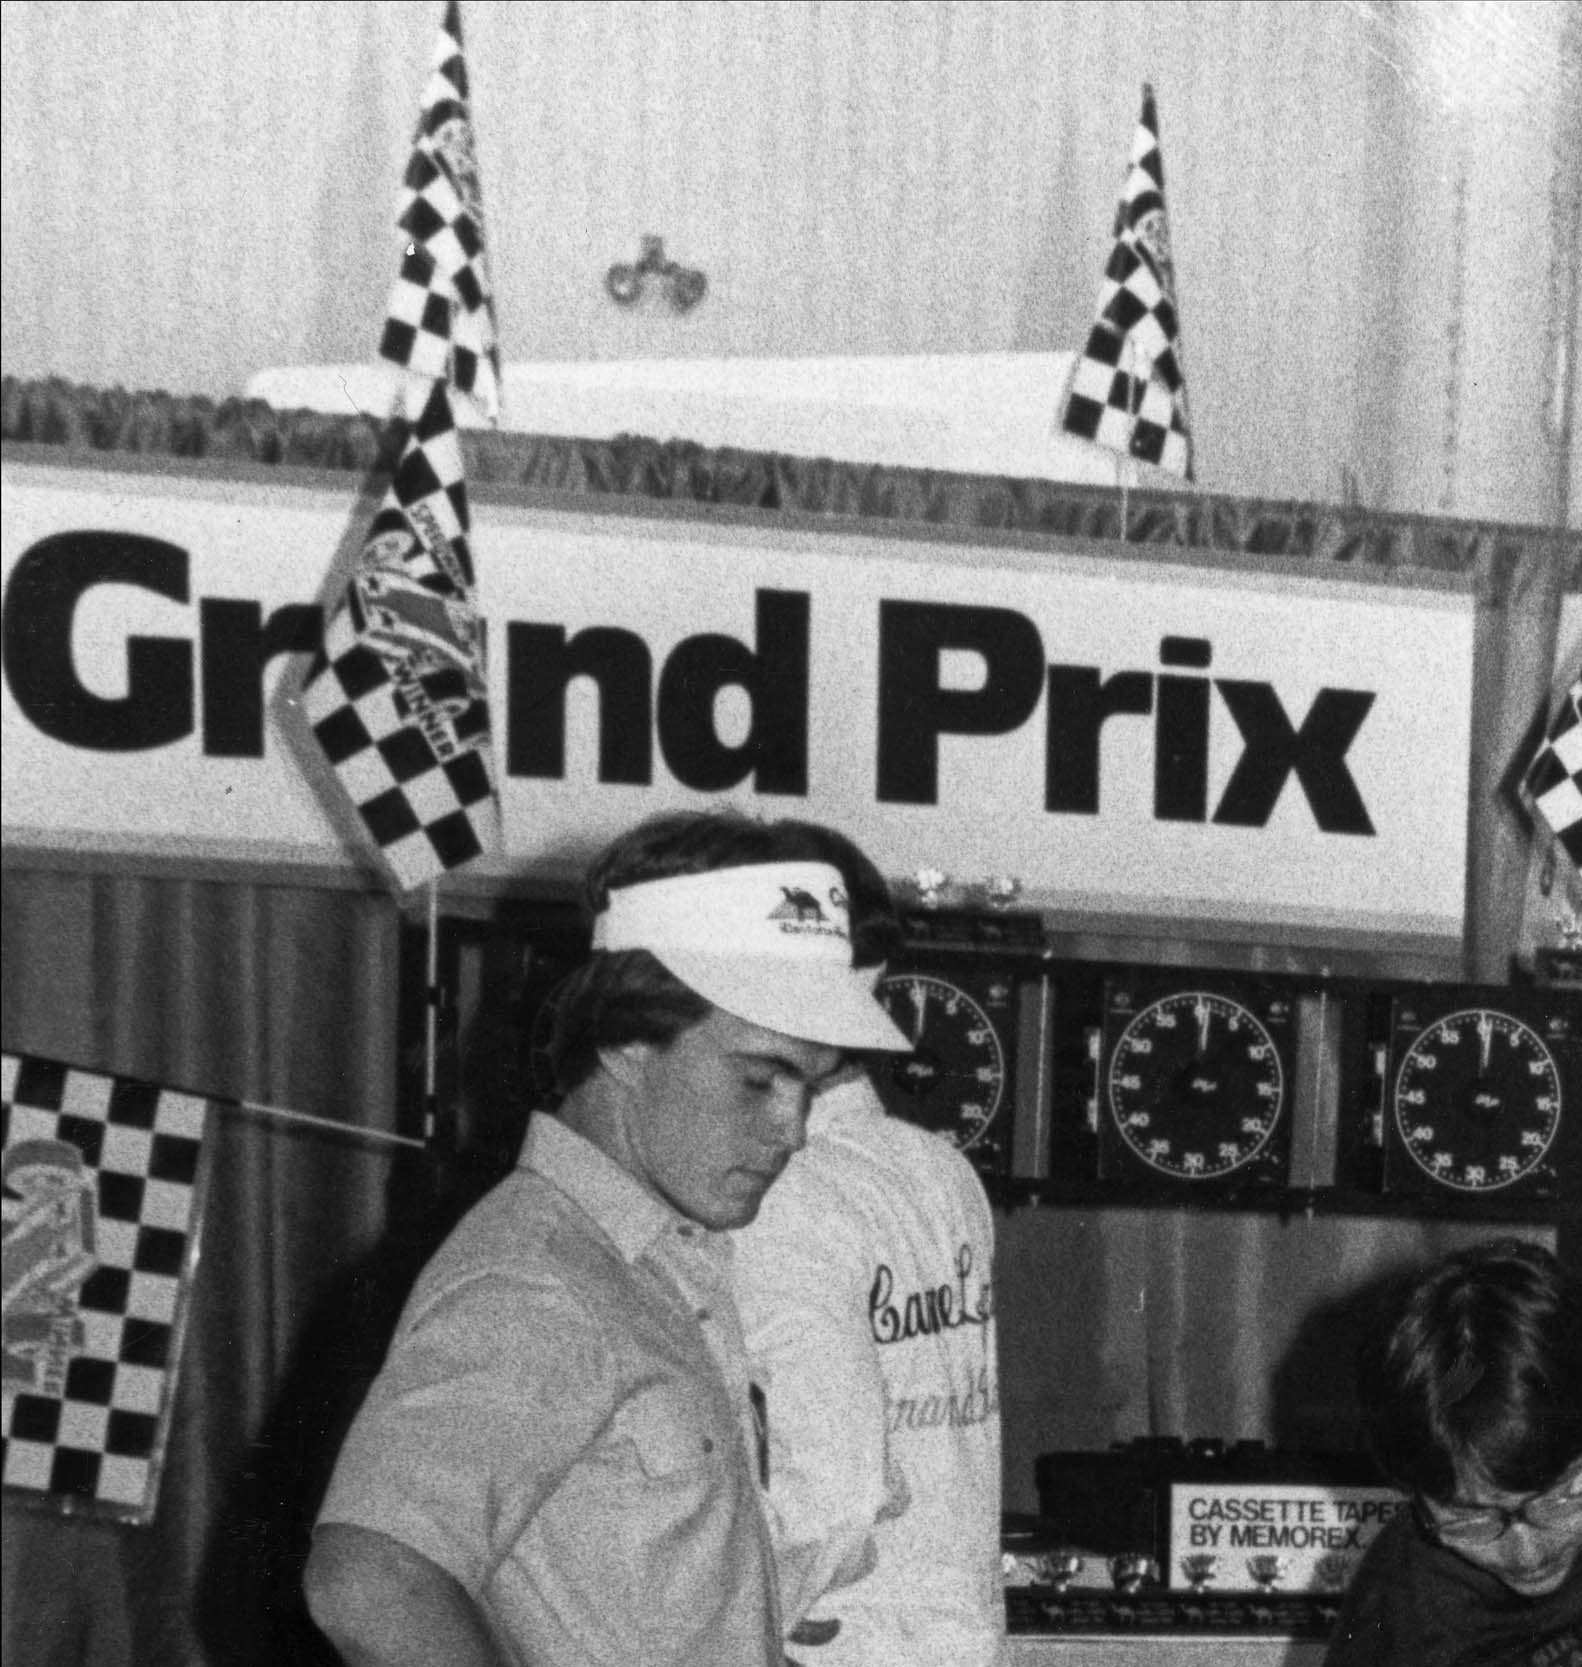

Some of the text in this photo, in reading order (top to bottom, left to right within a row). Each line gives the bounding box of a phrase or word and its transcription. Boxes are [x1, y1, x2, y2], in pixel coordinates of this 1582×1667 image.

[1, 530, 1377, 837] Grnd Prix
[394, 660, 457, 759] WINNER
[1188, 1498, 1325, 1523] CASSETTE
[1190, 1524, 1367, 1550] BY MEMOREX.
